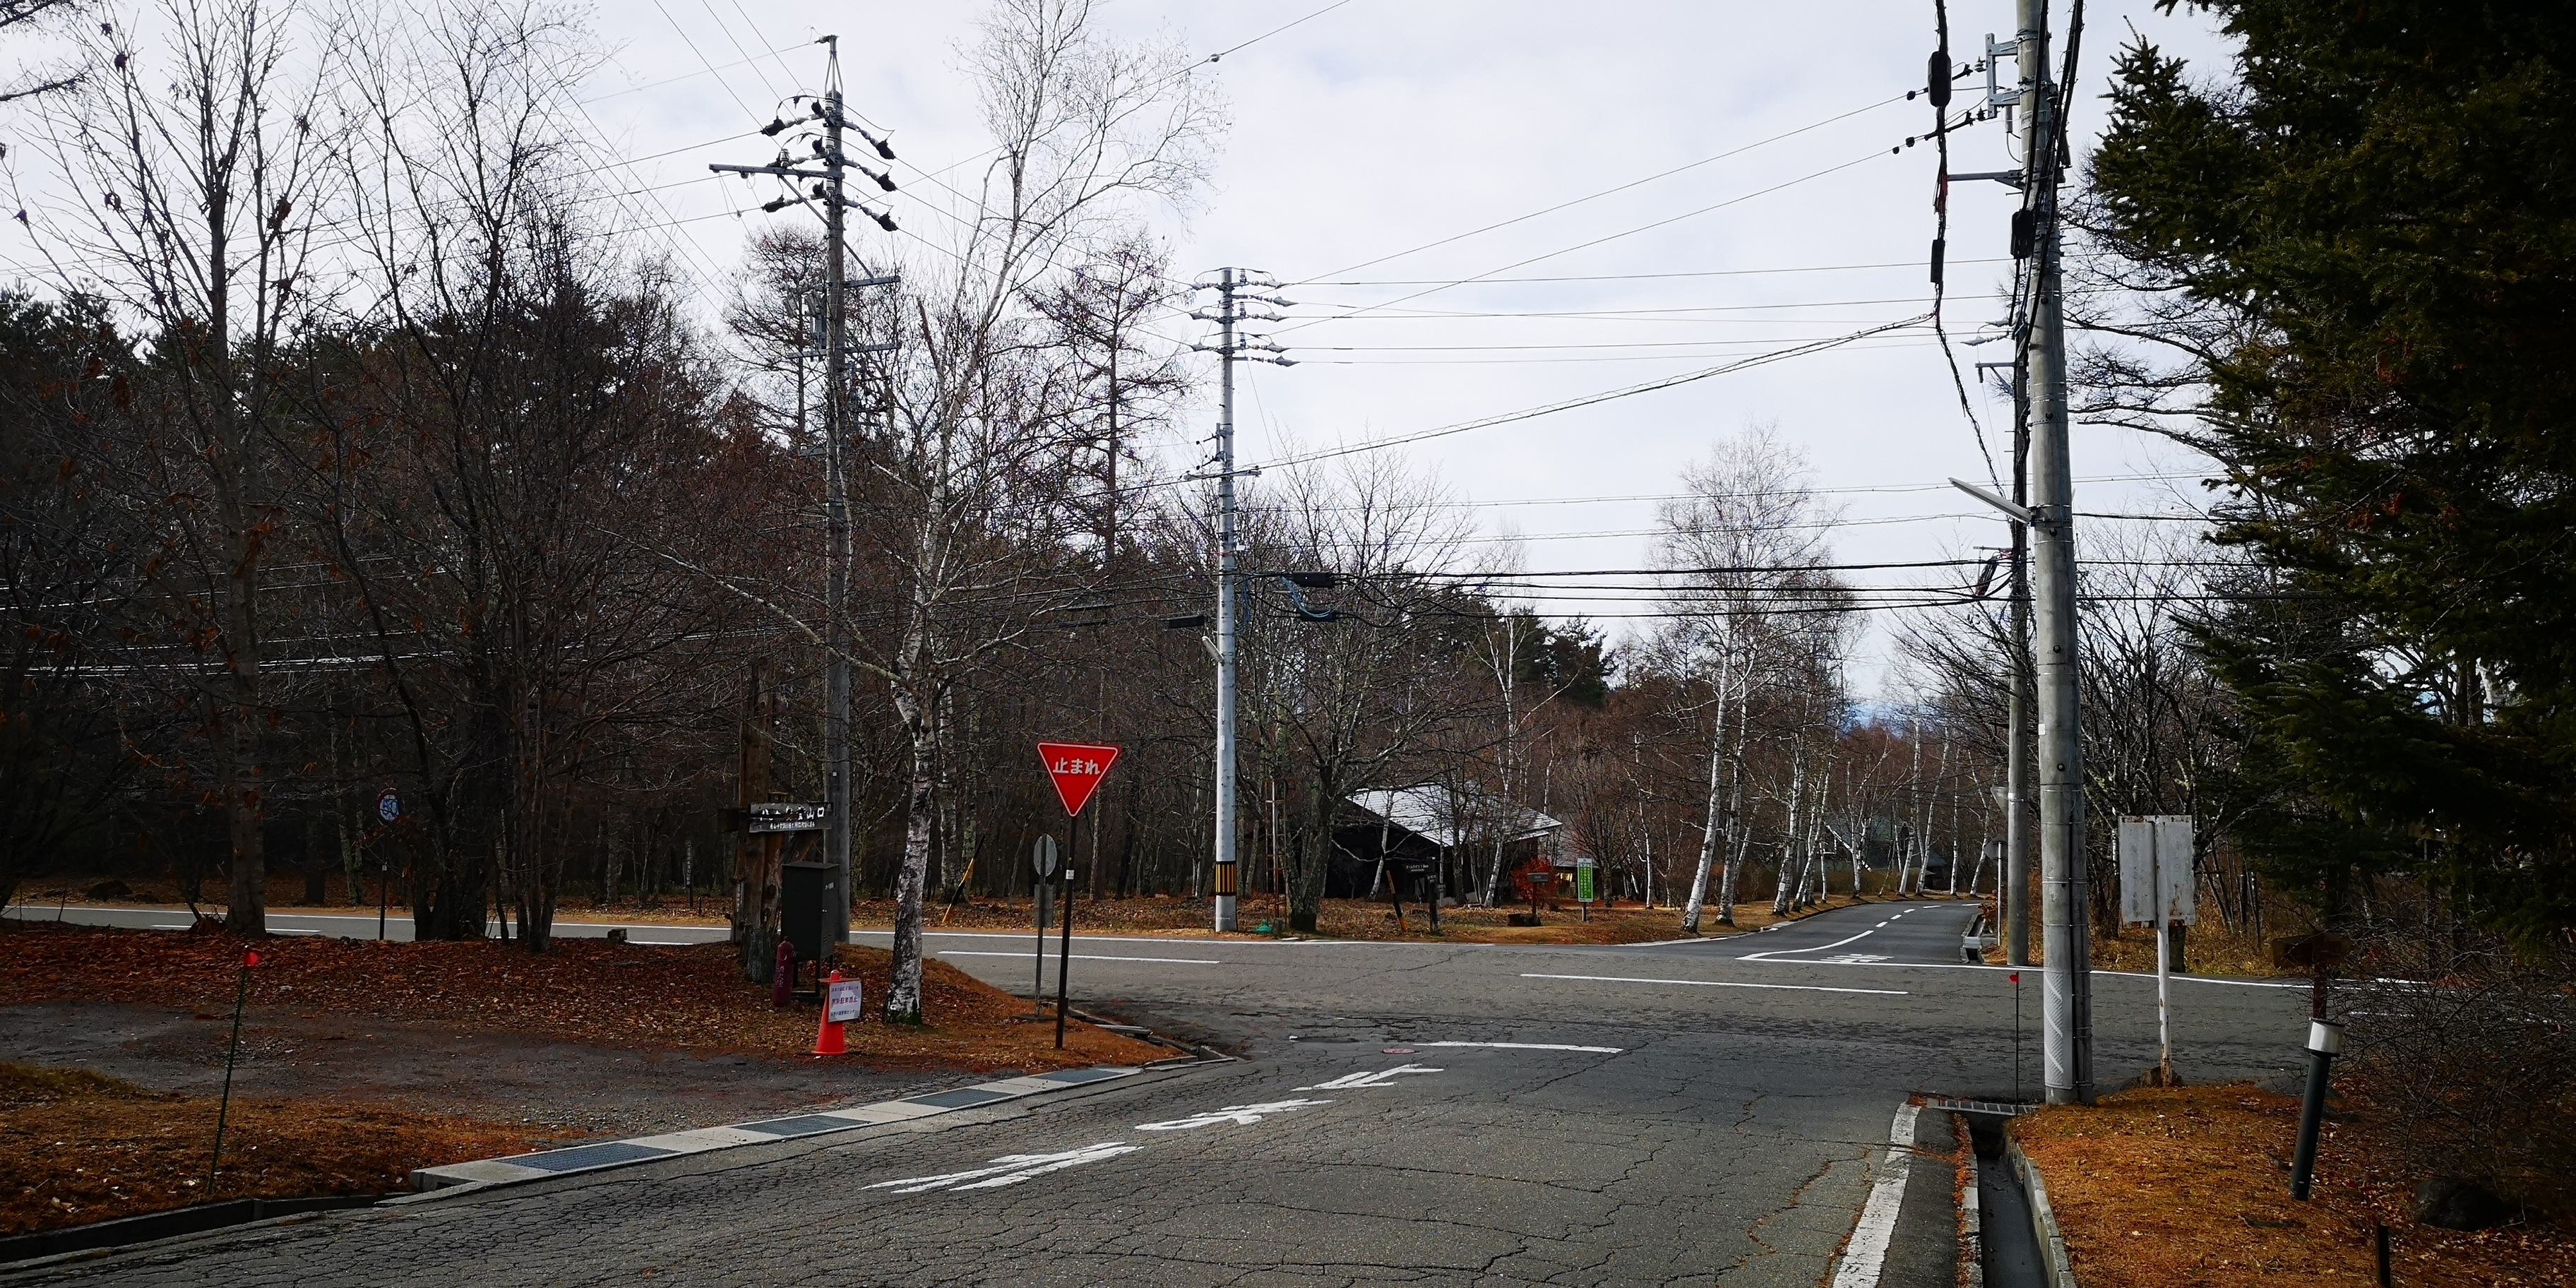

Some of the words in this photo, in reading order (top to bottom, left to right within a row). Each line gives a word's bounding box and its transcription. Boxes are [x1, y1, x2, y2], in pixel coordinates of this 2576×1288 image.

[1052, 757, 1100, 775] 止まれ
[861, 1063, 1444, 1193] 止まれ
